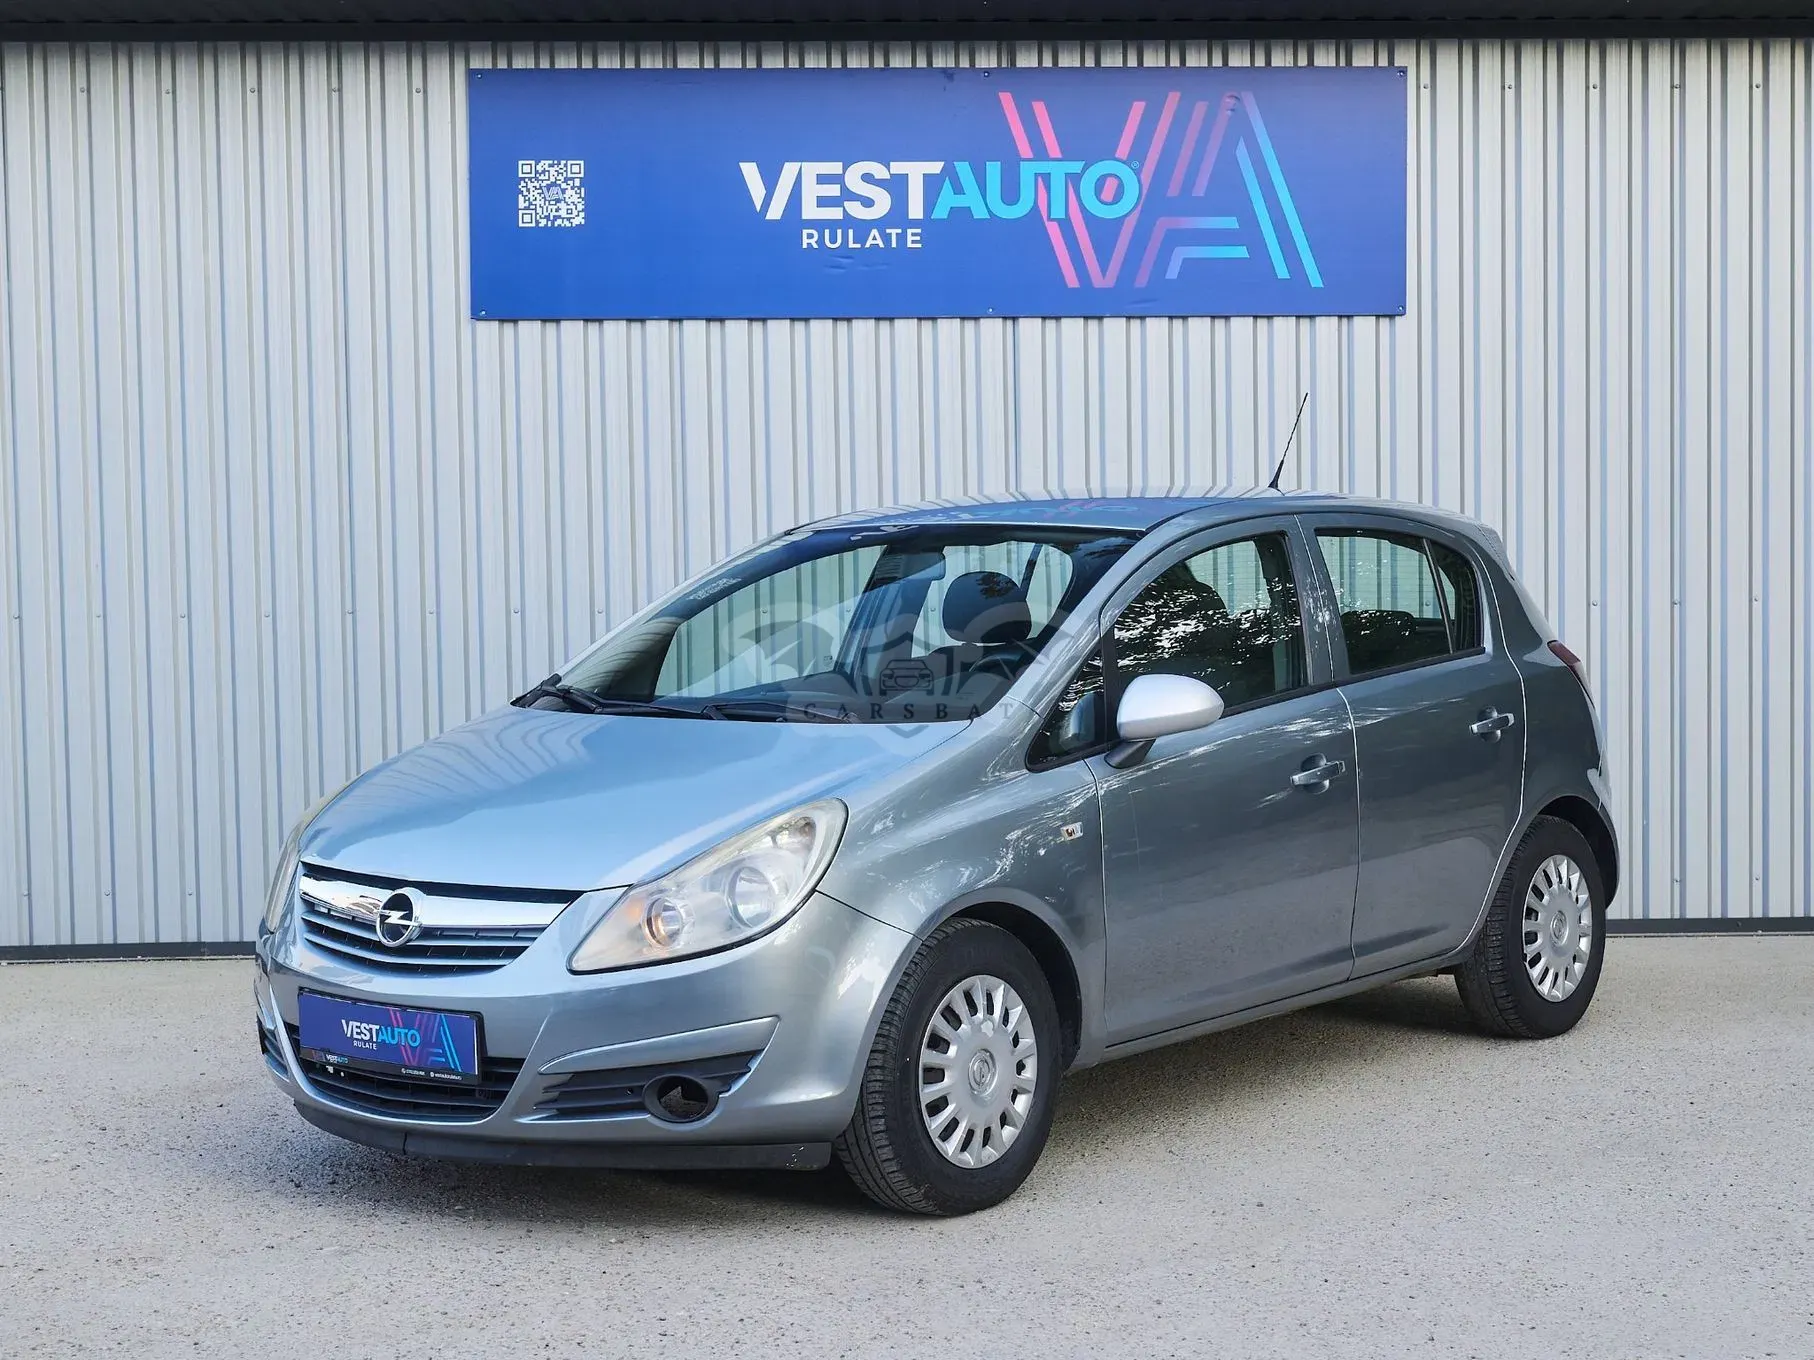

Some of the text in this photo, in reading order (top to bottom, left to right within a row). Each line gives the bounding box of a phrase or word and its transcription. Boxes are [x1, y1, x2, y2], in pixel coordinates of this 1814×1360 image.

[738, 160, 1139, 220] VESTAUTO
[802, 228, 922, 249] RULATE
[341, 1019, 421, 1048] VESTAUTO
[353, 1040, 377, 1051] RULATE
